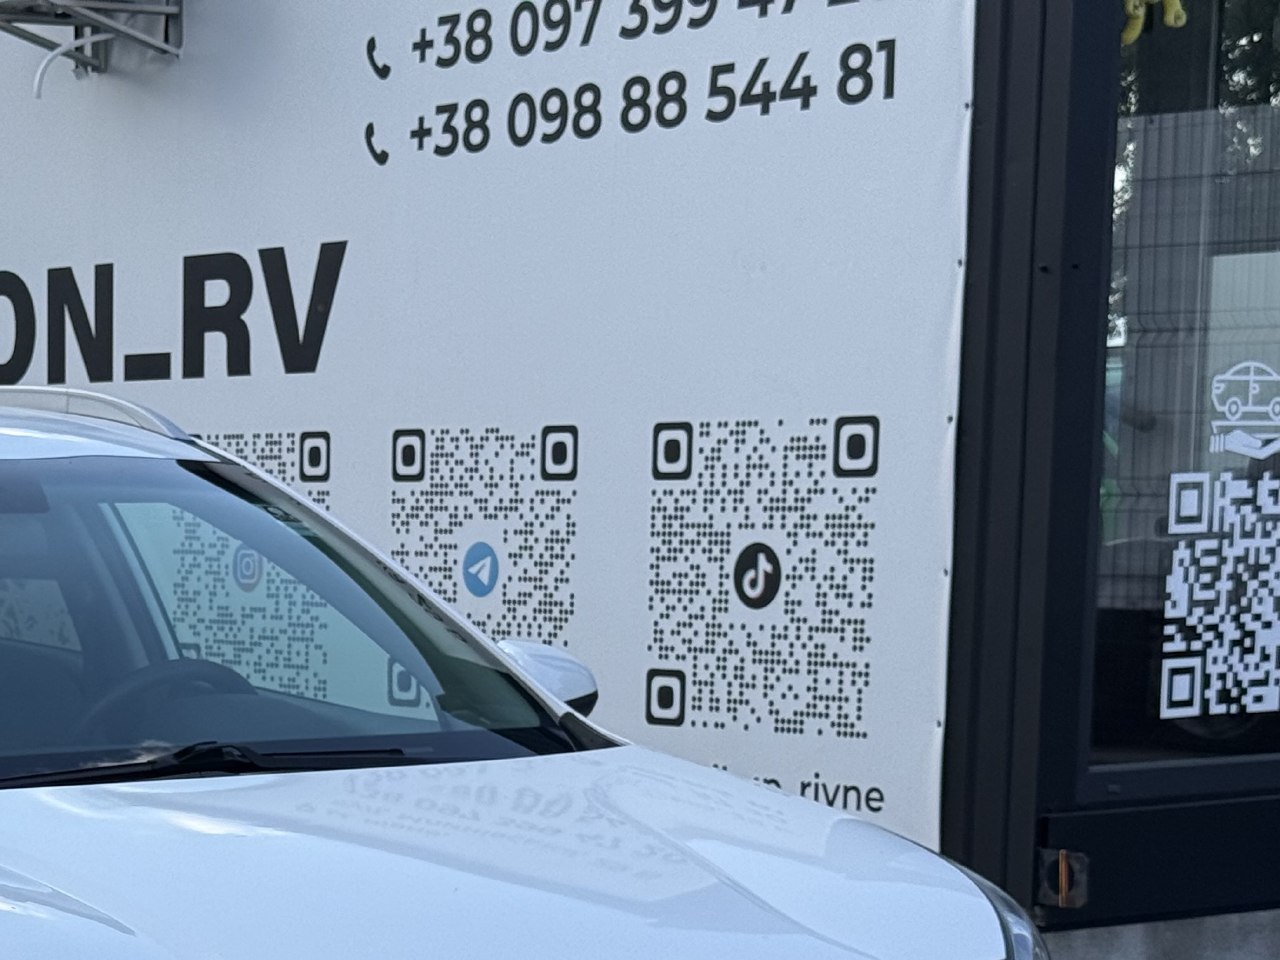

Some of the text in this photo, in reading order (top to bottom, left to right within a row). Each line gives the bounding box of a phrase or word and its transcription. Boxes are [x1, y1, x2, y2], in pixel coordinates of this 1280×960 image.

[412, 9, 493, 68] +38
[510, 0, 602, 56] 097
[410, 38, 897, 157] +38 098 88 544 81
